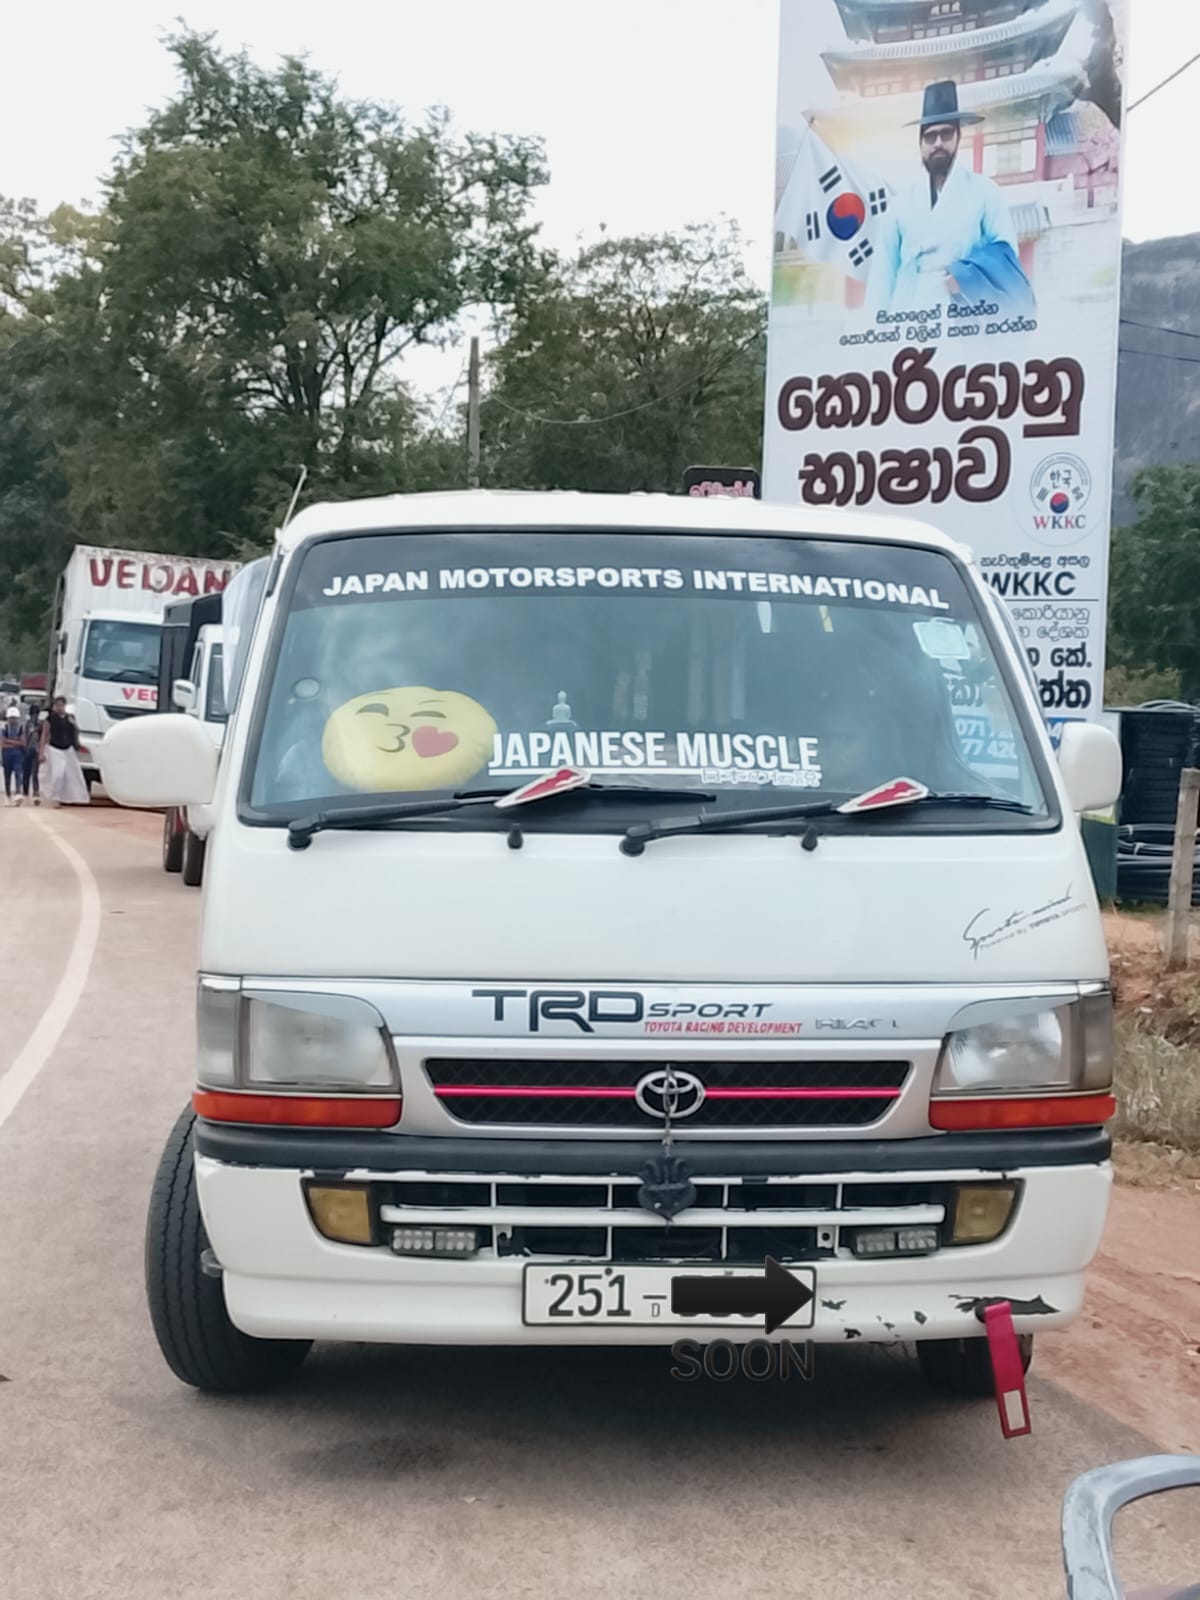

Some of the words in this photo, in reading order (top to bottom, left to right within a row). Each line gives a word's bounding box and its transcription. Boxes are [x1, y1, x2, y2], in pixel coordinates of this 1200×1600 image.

[777, 346, 1086, 438] කොරියානු
[799, 425, 1012, 506] භාෂාව
[1033, 514, 1087, 531] WKKC
[322, 570, 429, 597] JAPAN
[439, 567, 684, 590] MOTORSPORTS
[693, 569, 950, 610] INTERNATIONAL
[981, 571, 1077, 596] WKKC
[488, 731, 669, 768] JAPANESE
[676, 732, 822, 772] MUSCLE
[471, 989, 644, 1034] TRD
[647, 1002, 773, 1018] SPORT
[644, 1020, 683, 1033] TOYOTA
[685, 1020, 725, 1033] RACING
[727, 1021, 803, 1035] DEVELOPMENT
[548, 1273, 632, 1318] 251
